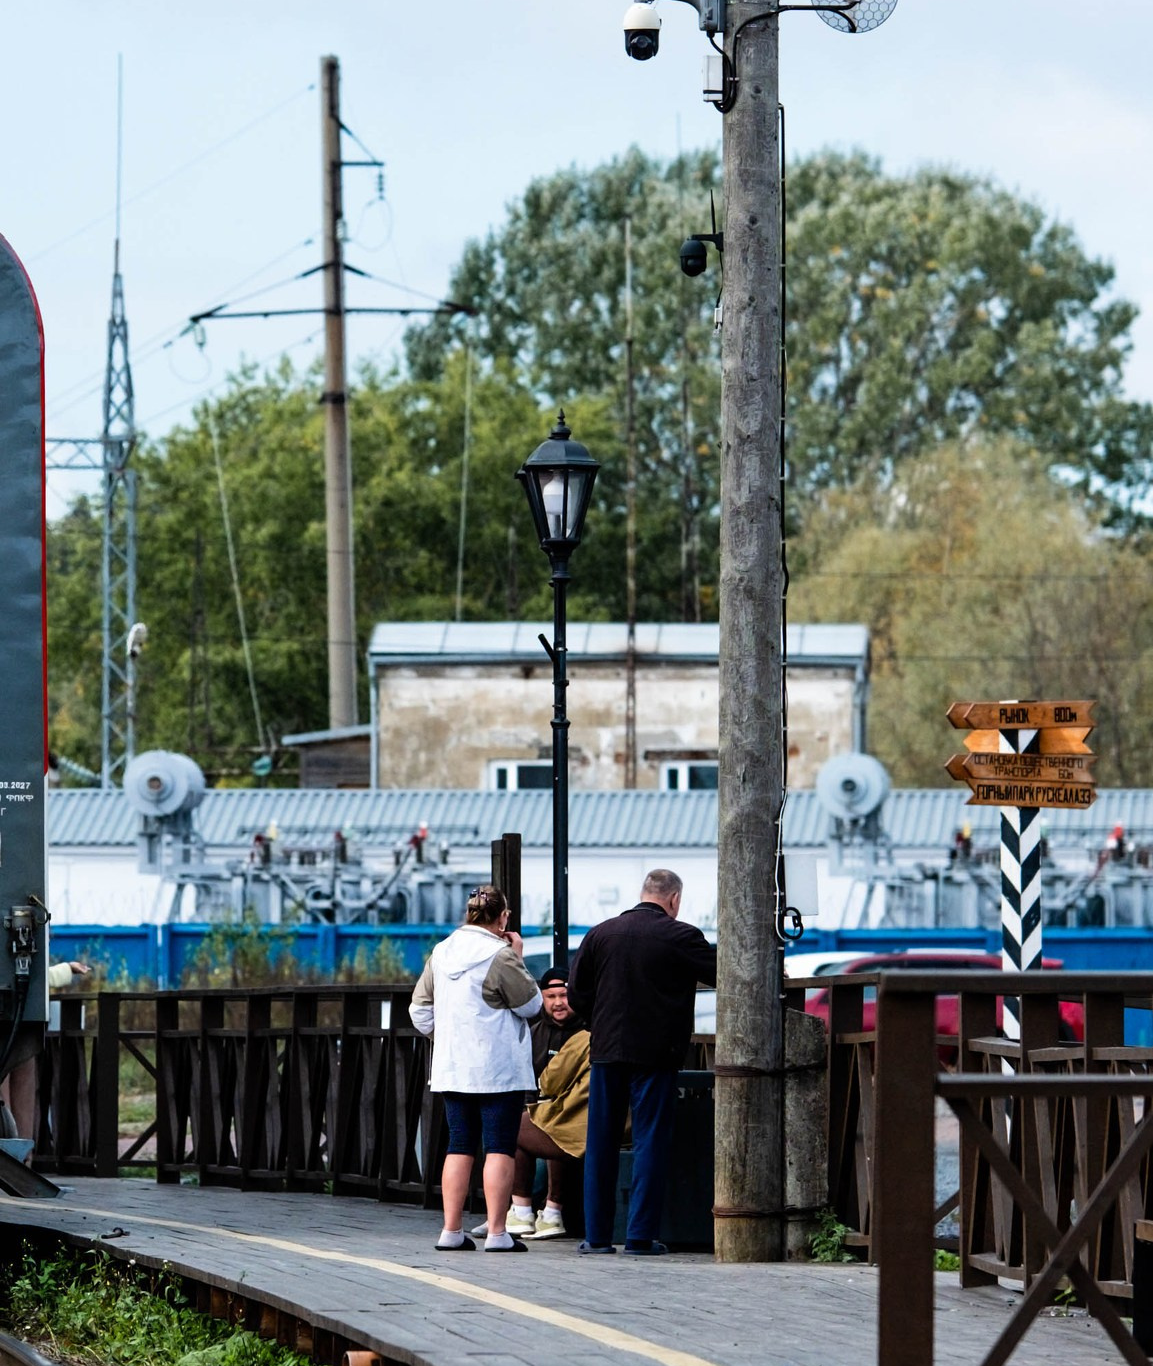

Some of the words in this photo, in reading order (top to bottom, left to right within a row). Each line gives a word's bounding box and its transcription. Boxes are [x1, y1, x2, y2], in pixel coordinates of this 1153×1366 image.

[999, 708, 1030, 723] РЫНОК
[1054, 707, 1077, 722] 800м
[974, 754, 1017, 765] ОСТАНОВКА
[1020, 755, 1083, 769] ОБЩЕСТВЕННОГО
[994, 766, 1041, 778] ТРАНСПОРТА
[6, 794, 34, 802] ФПКФ
[976, 783, 1010, 800] ГОРНЫЙ
[1011, 786, 1034, 801] ПАРК
[1036, 787, 1079, 803] РУСКЕАЛА
